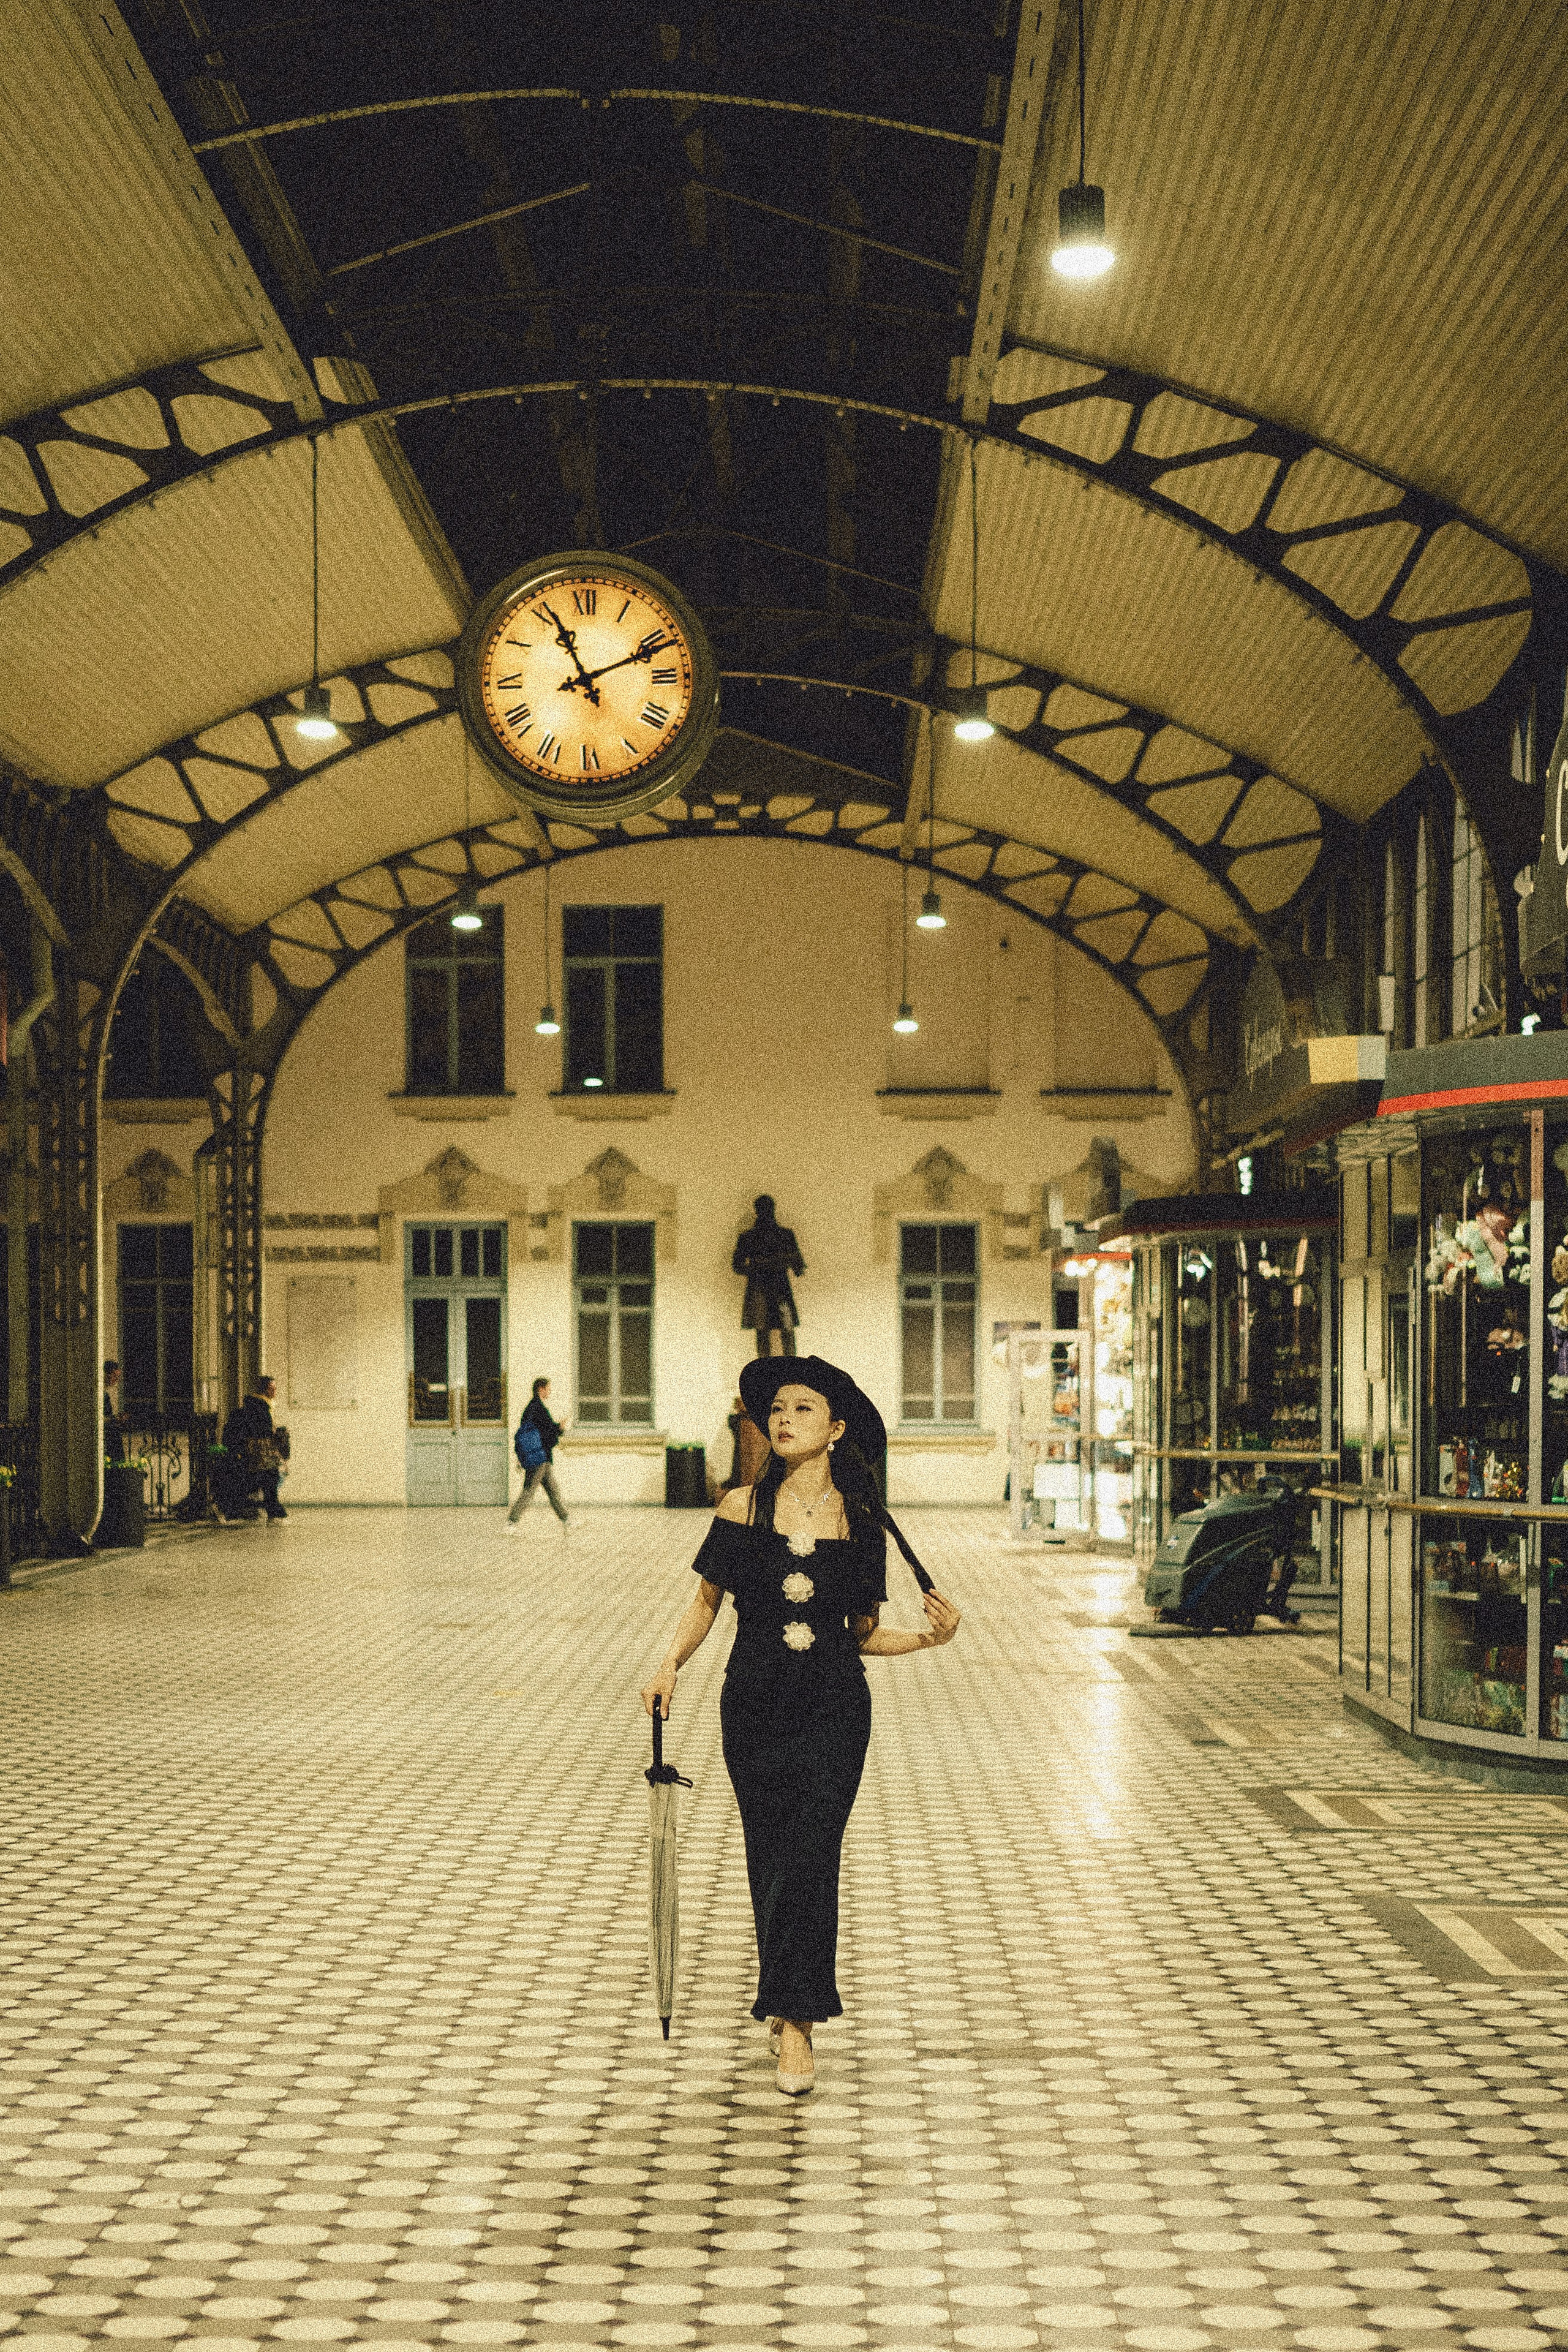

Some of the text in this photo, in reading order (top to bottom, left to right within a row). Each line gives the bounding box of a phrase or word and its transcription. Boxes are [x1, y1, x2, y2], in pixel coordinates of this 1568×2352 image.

[573, 590, 596, 615] XII
[616, 600, 631, 623] I
[640, 628, 666, 648] II
[497, 672, 522, 690] IX
[652, 668, 677, 685] III
[505, 703, 534, 739] VIII
[640, 701, 669, 730] IIII
[537, 734, 562, 764] VII
[581, 744, 600, 771] VI
